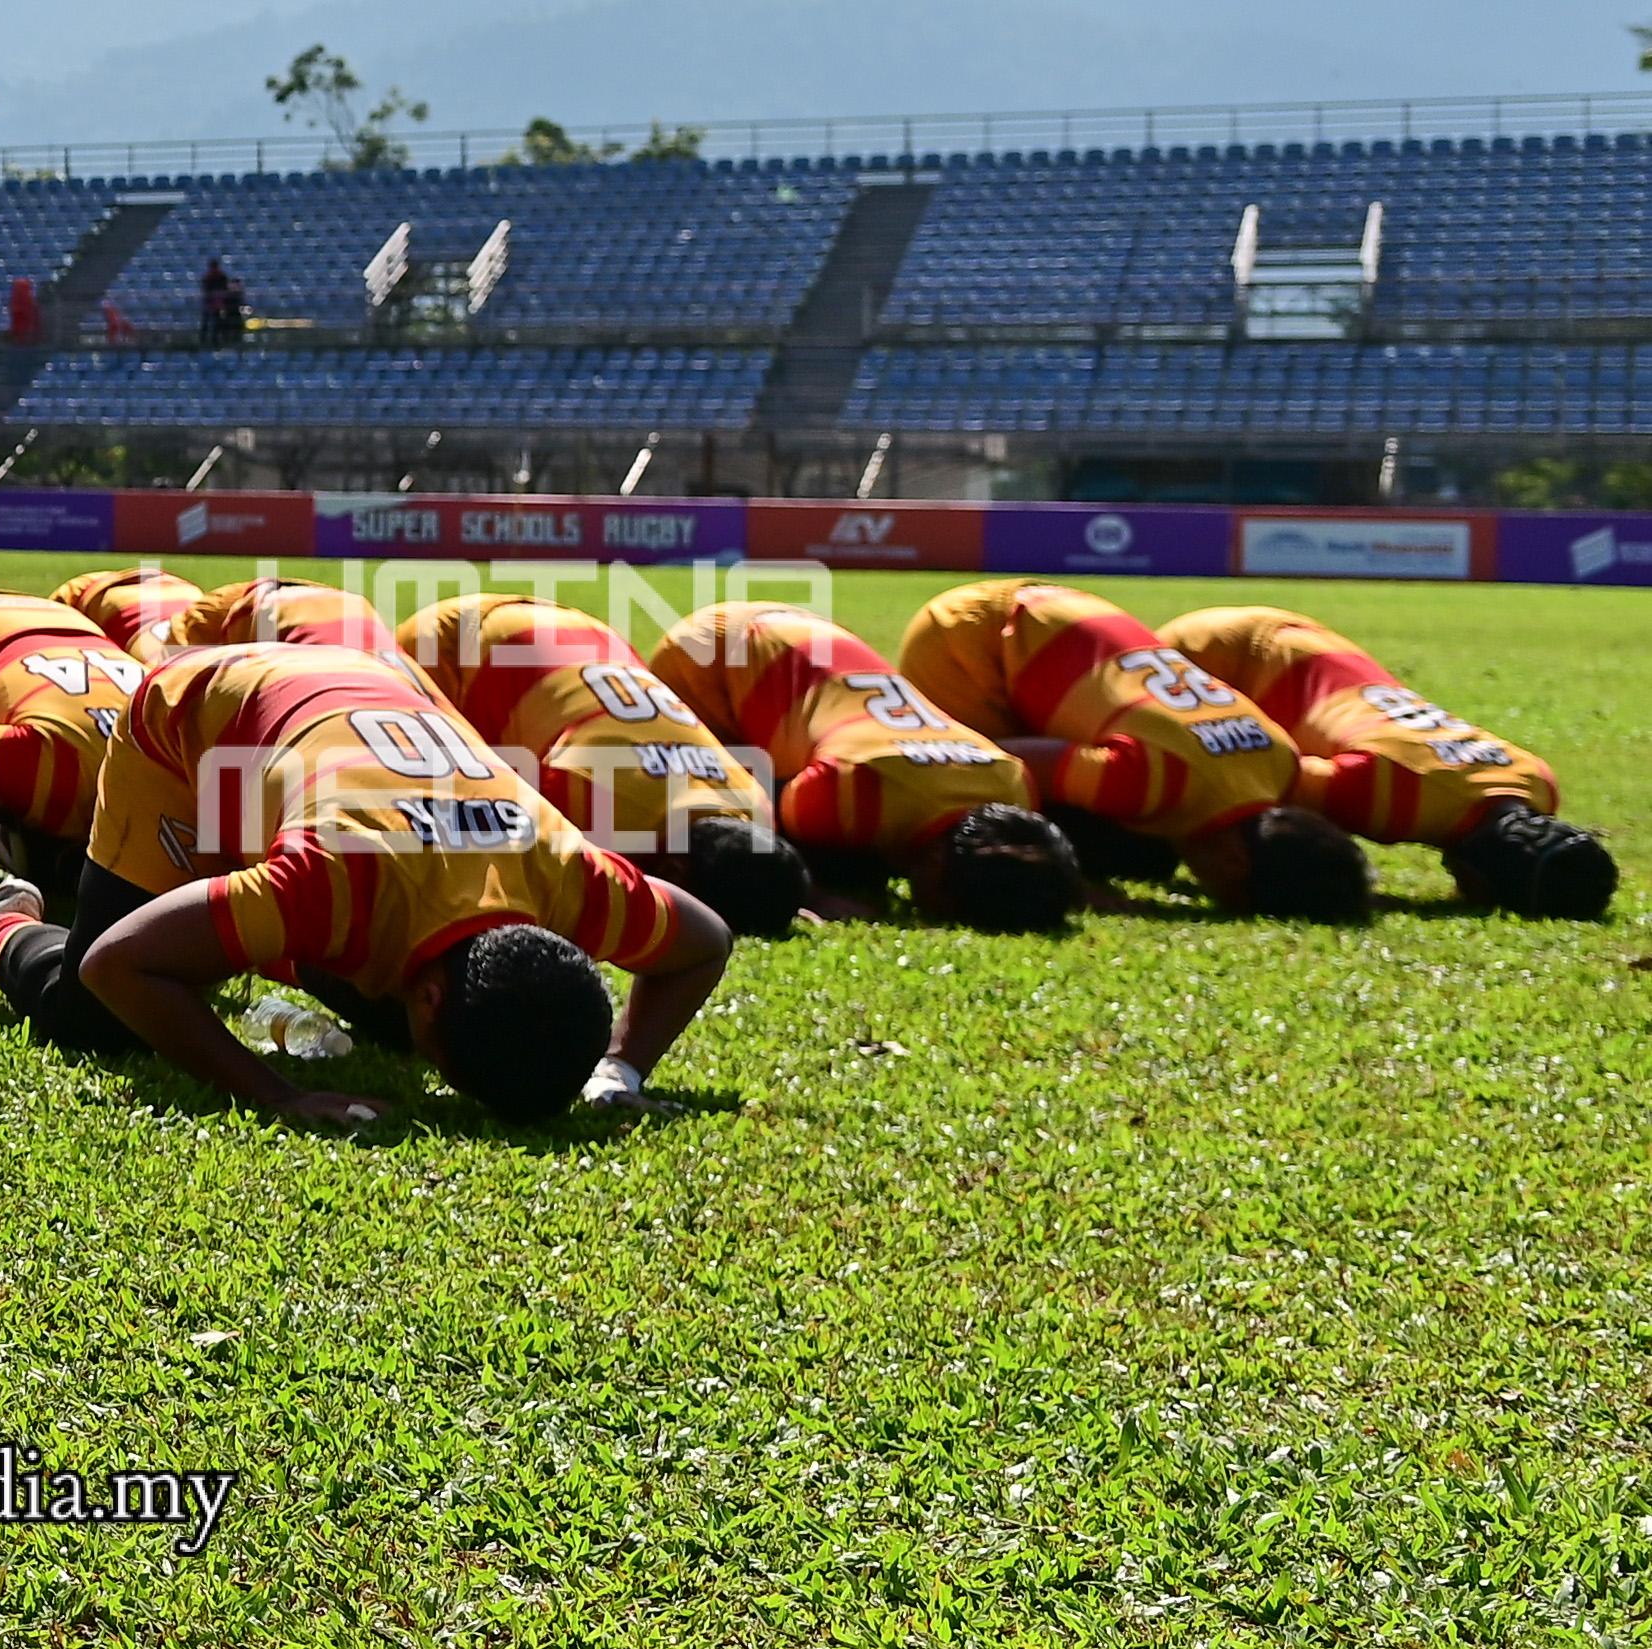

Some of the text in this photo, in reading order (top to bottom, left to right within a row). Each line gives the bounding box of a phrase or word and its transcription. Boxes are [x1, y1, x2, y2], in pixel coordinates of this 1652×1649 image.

[351, 510, 695, 546] SUPER SCHOOLS RUGBY
[348, 709, 494, 780] 10
[393, 798, 536, 848] SDAR
